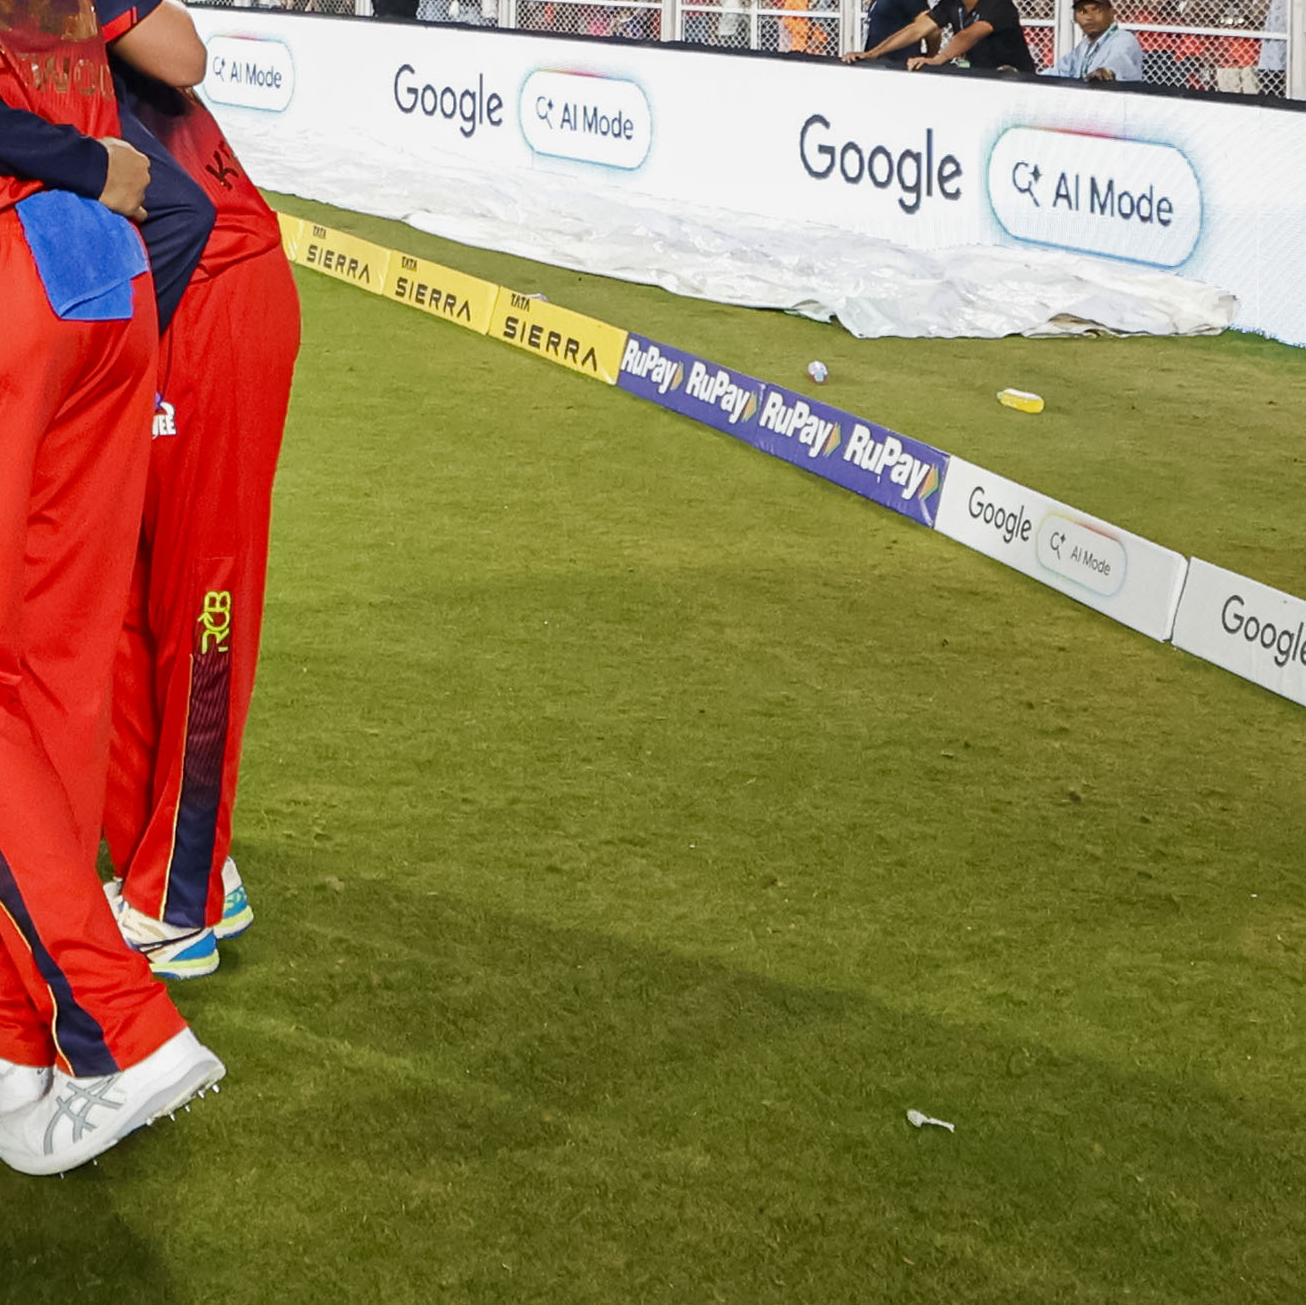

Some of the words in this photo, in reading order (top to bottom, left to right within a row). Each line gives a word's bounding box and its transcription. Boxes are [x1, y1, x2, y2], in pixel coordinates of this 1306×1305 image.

[231, 64, 242, 84] AI
[245, 65, 283, 89] Mode
[394, 63, 503, 138] Google
[560, 104, 578, 132] AI
[582, 105, 635, 141] Mode
[800, 114, 963, 215] Google
[1052, 172, 1080, 211] AI
[1089, 176, 1174, 227] Mode
[307, 244, 370, 284] SIERRA
[401, 256, 417, 272] TATA
[395, 277, 471, 322] SIERRA
[511, 293, 530, 312] TATA
[503, 316, 598, 372] SIERRA
[621, 339, 678, 394] RuPay
[685, 361, 750, 424] RuPay
[759, 392, 833, 458] RuPay
[843, 424, 930, 500] RuPay
[968, 486, 1032, 544] Google
[1070, 546, 1082, 564] AI
[1083, 549, 1111, 577] Mode
